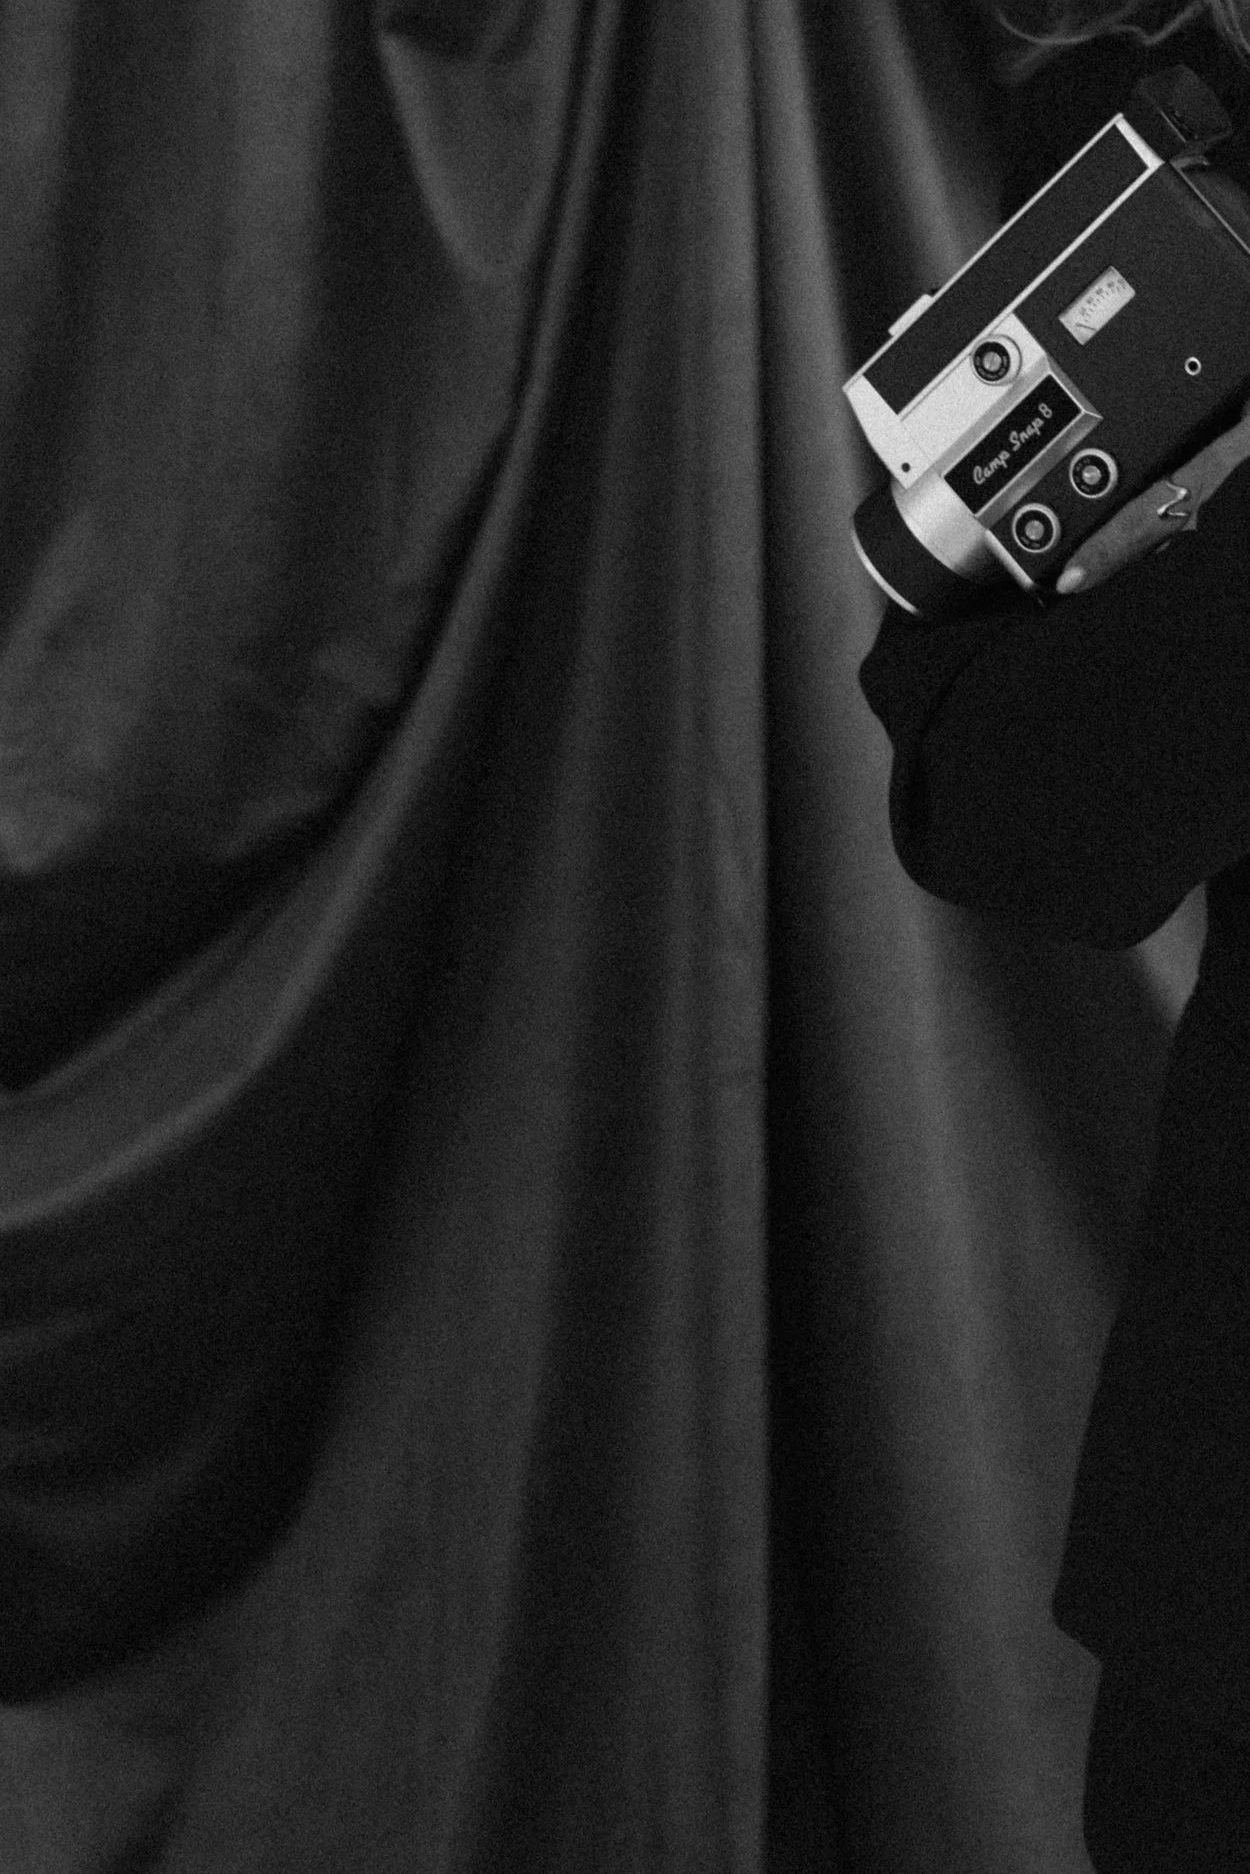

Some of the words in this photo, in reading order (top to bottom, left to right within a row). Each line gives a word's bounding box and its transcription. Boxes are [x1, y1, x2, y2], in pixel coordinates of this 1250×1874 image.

[973, 451, 1010, 485] Camp
[1009, 418, 1044, 452] Snap
[1038, 402, 1053, 419] 8
